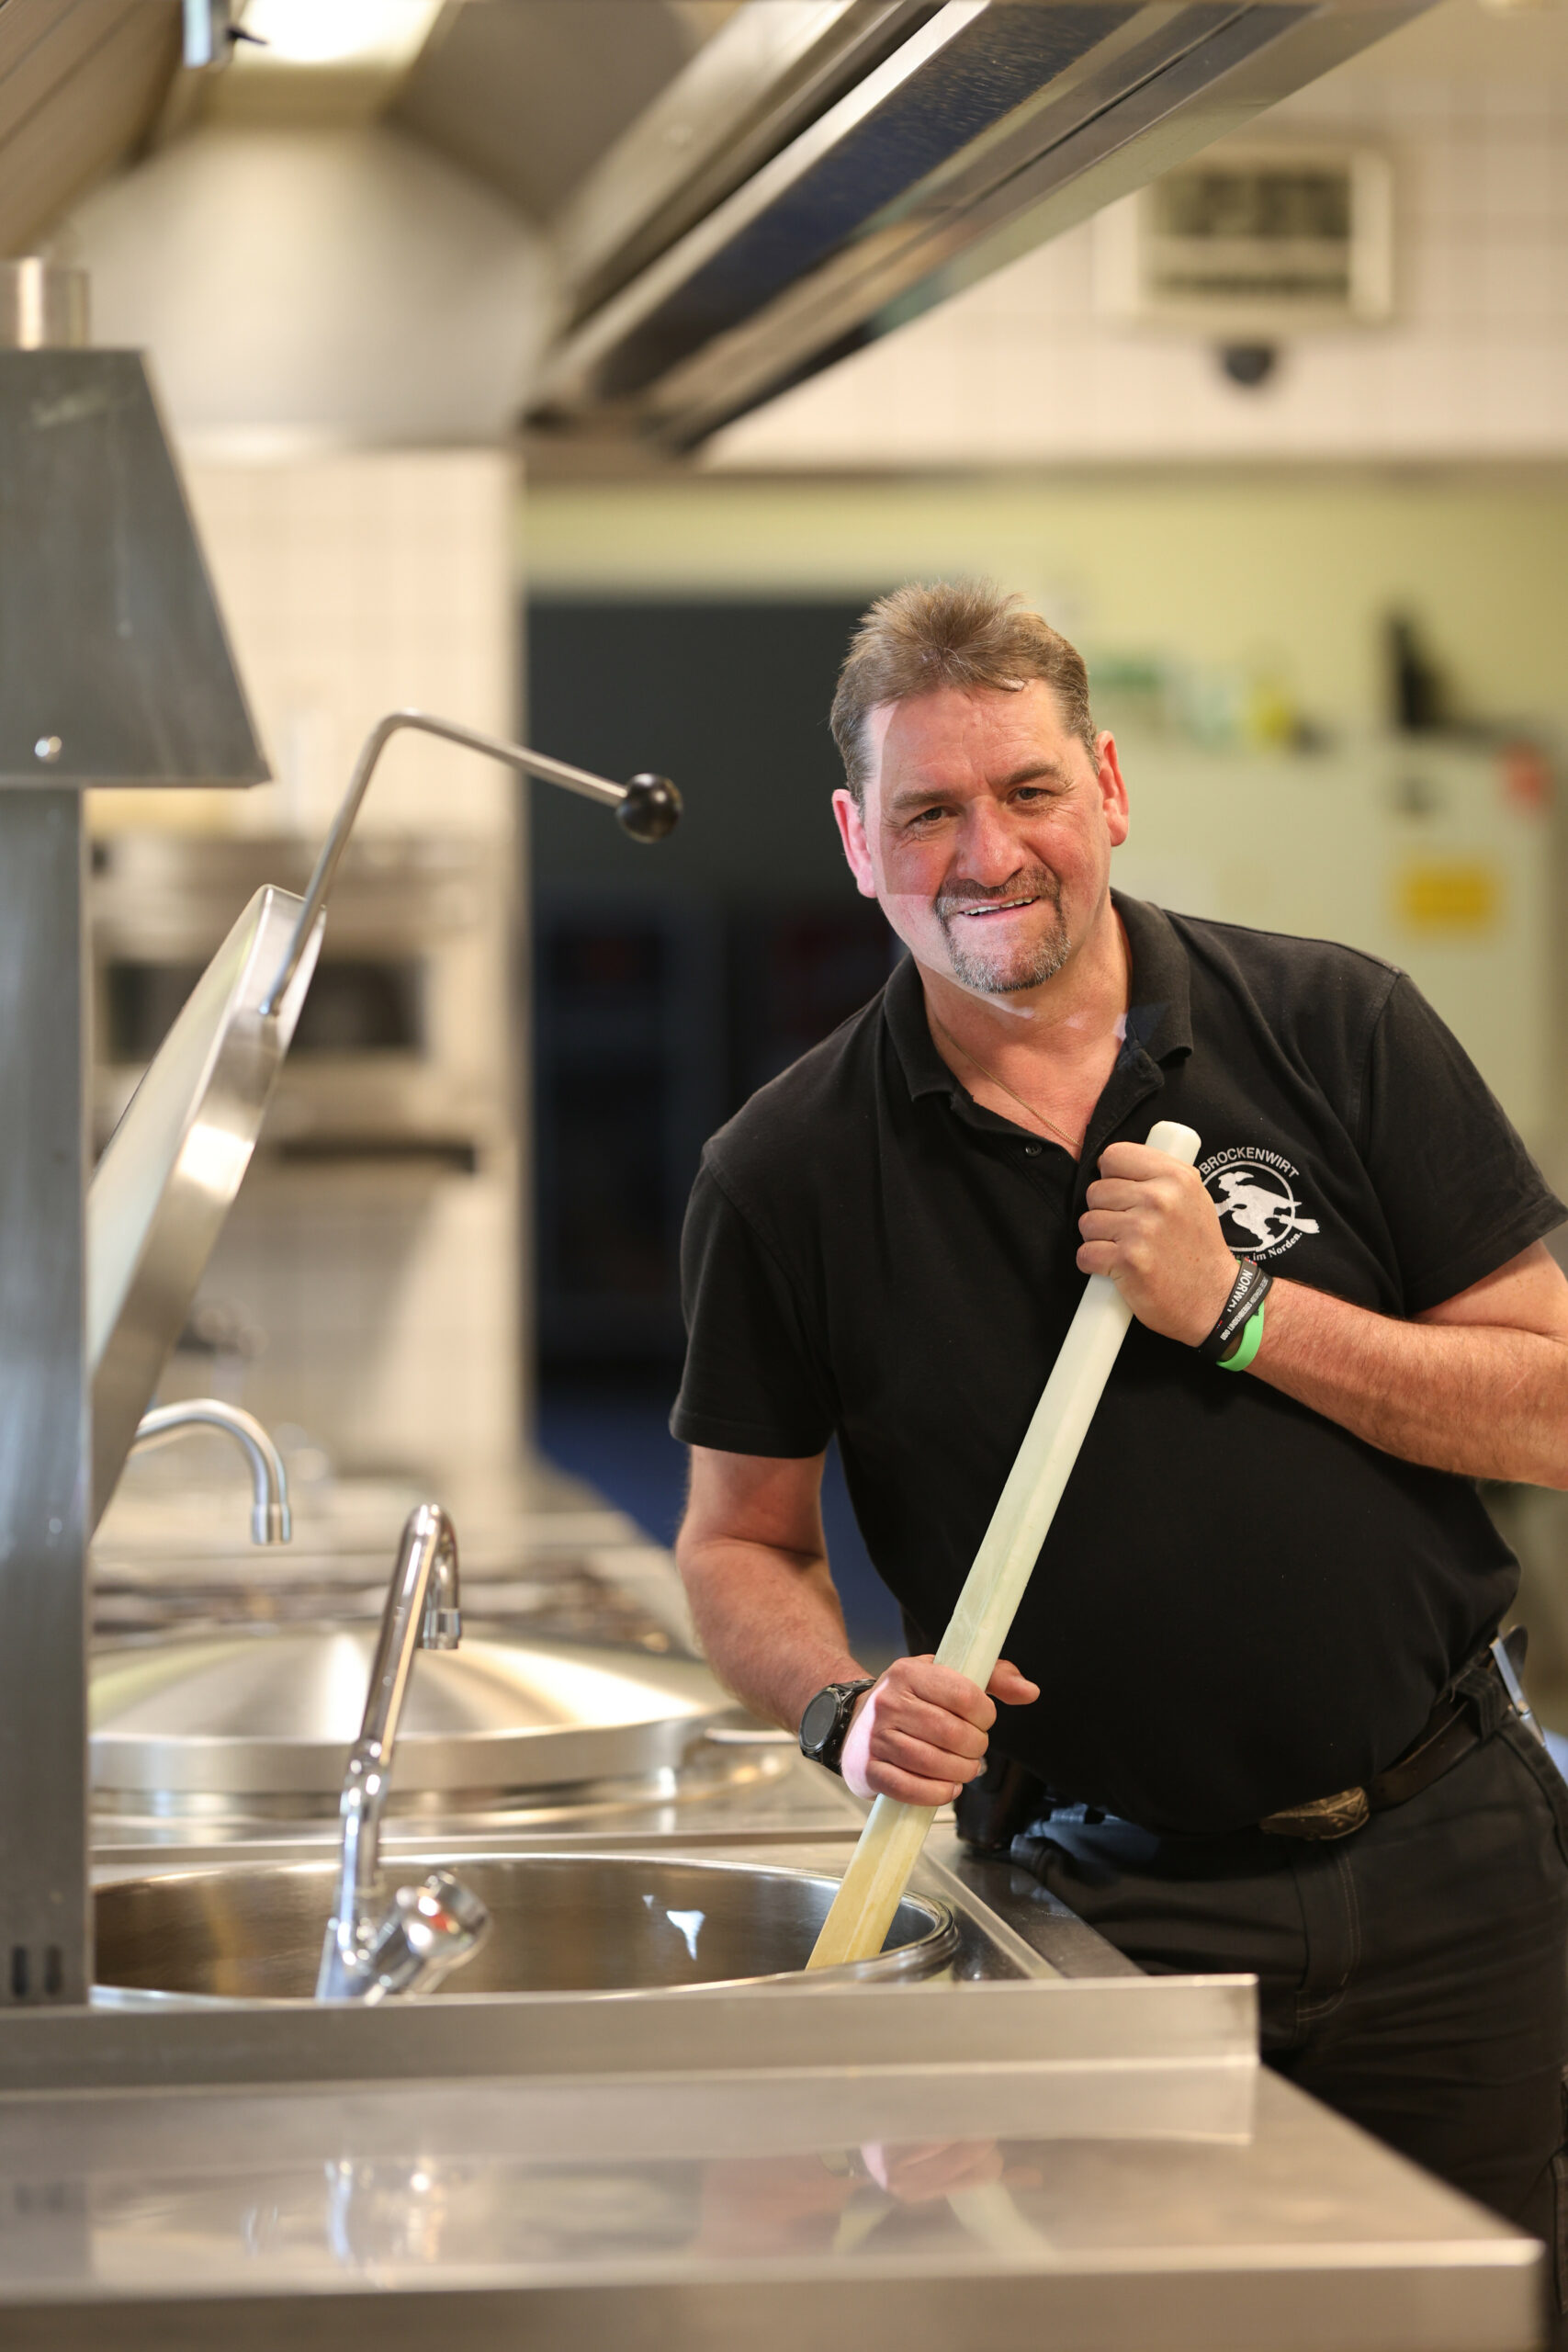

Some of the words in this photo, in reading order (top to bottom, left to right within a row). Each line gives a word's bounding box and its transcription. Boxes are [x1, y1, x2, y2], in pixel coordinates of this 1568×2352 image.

[1199, 1147, 1300, 1179] BROCKENWIRT
[1253, 1252, 1267, 1261] im
[1268, 1232, 1303, 1258] Norden.
